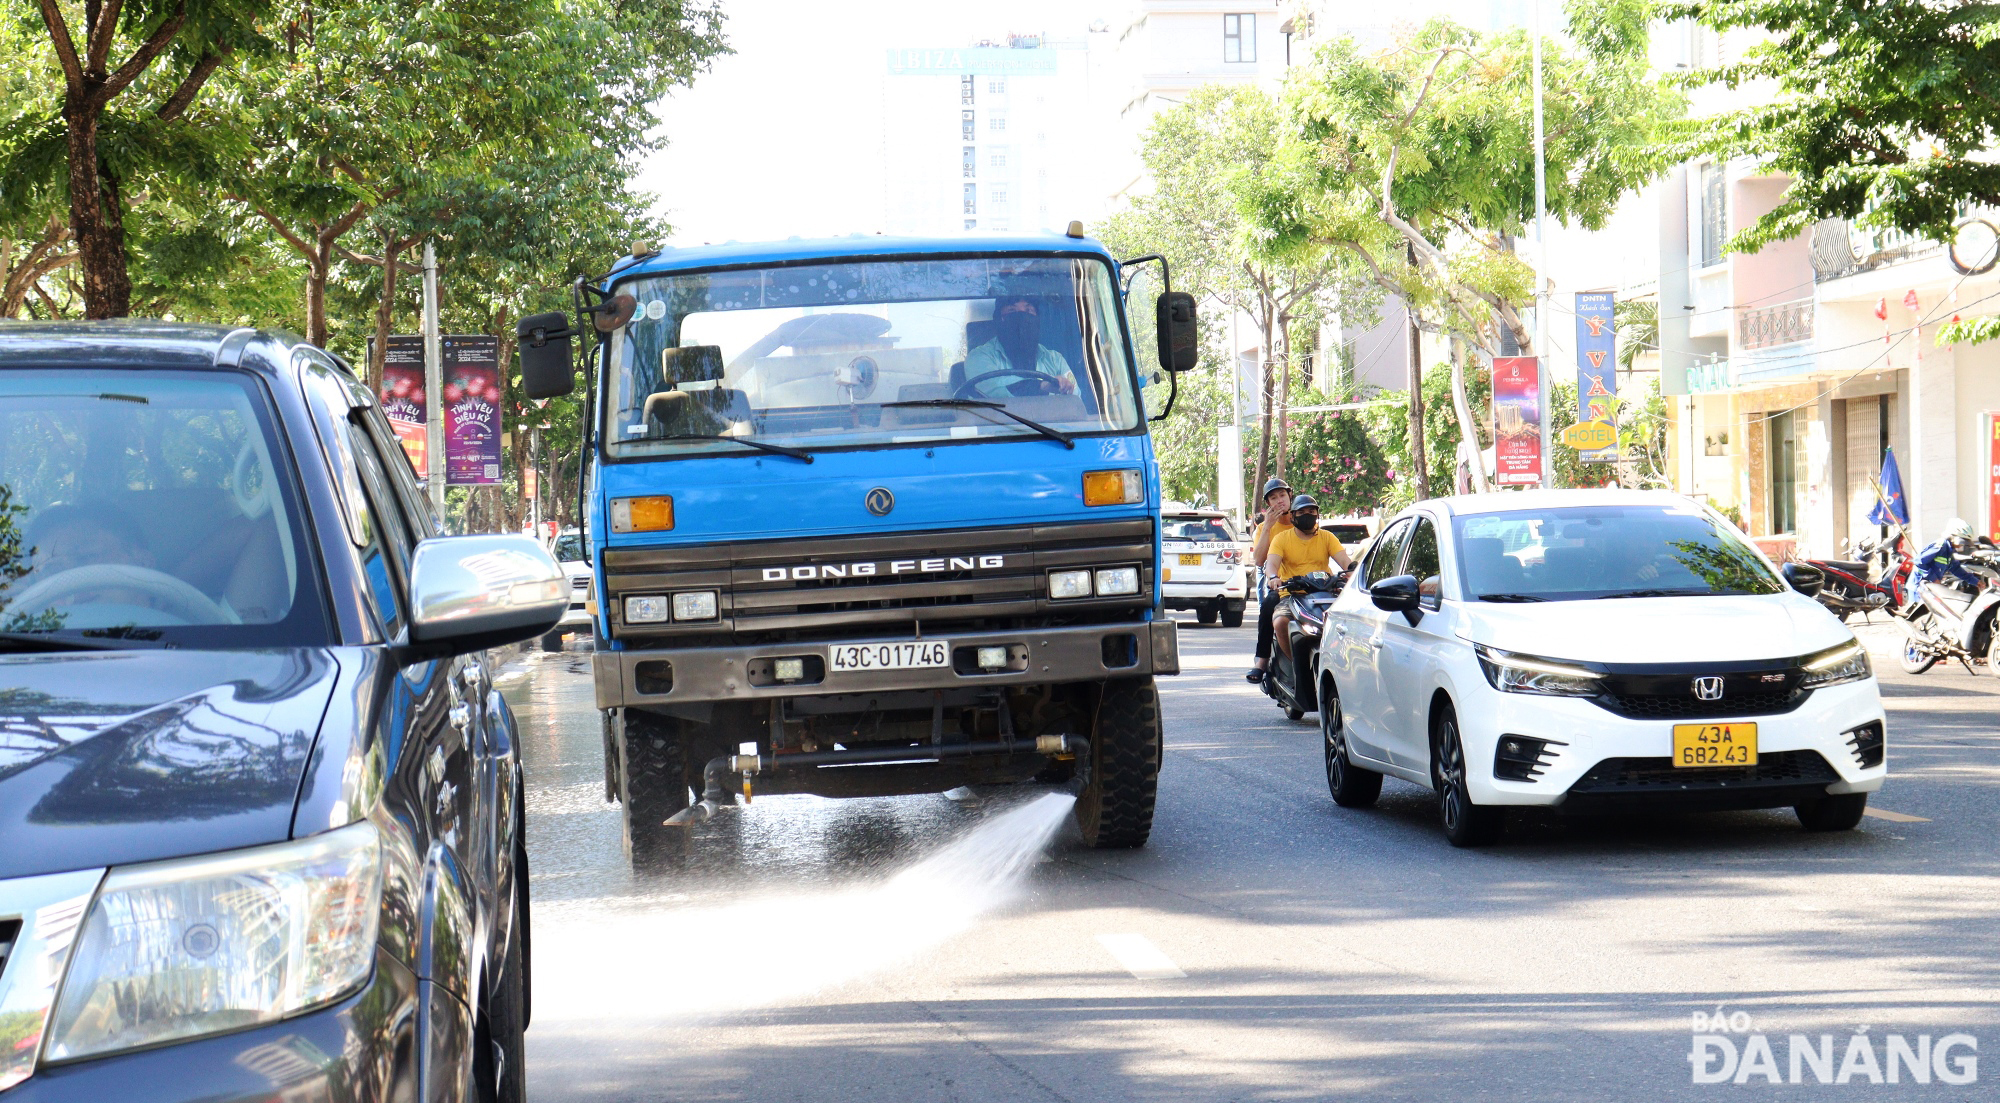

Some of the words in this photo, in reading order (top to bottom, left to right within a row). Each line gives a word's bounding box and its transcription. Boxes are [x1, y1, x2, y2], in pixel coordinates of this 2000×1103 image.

[892, 49, 963, 73] IBIZA
[381, 404, 399, 414] ÌNH
[450, 404, 473, 415] TÌNH
[474, 402, 494, 415] YÊU
[454, 411, 476, 424] DIỆU
[1568, 429, 1613, 442] HOTEL
[762, 562, 876, 581] DONG
[890, 555, 1004, 574] FENG
[834, 643, 945, 668] 43C-017.46
[1760, 673, 1786, 683] RS
[1698, 726, 1733, 743] 43A
[1683, 745, 1748, 764] 682.43
